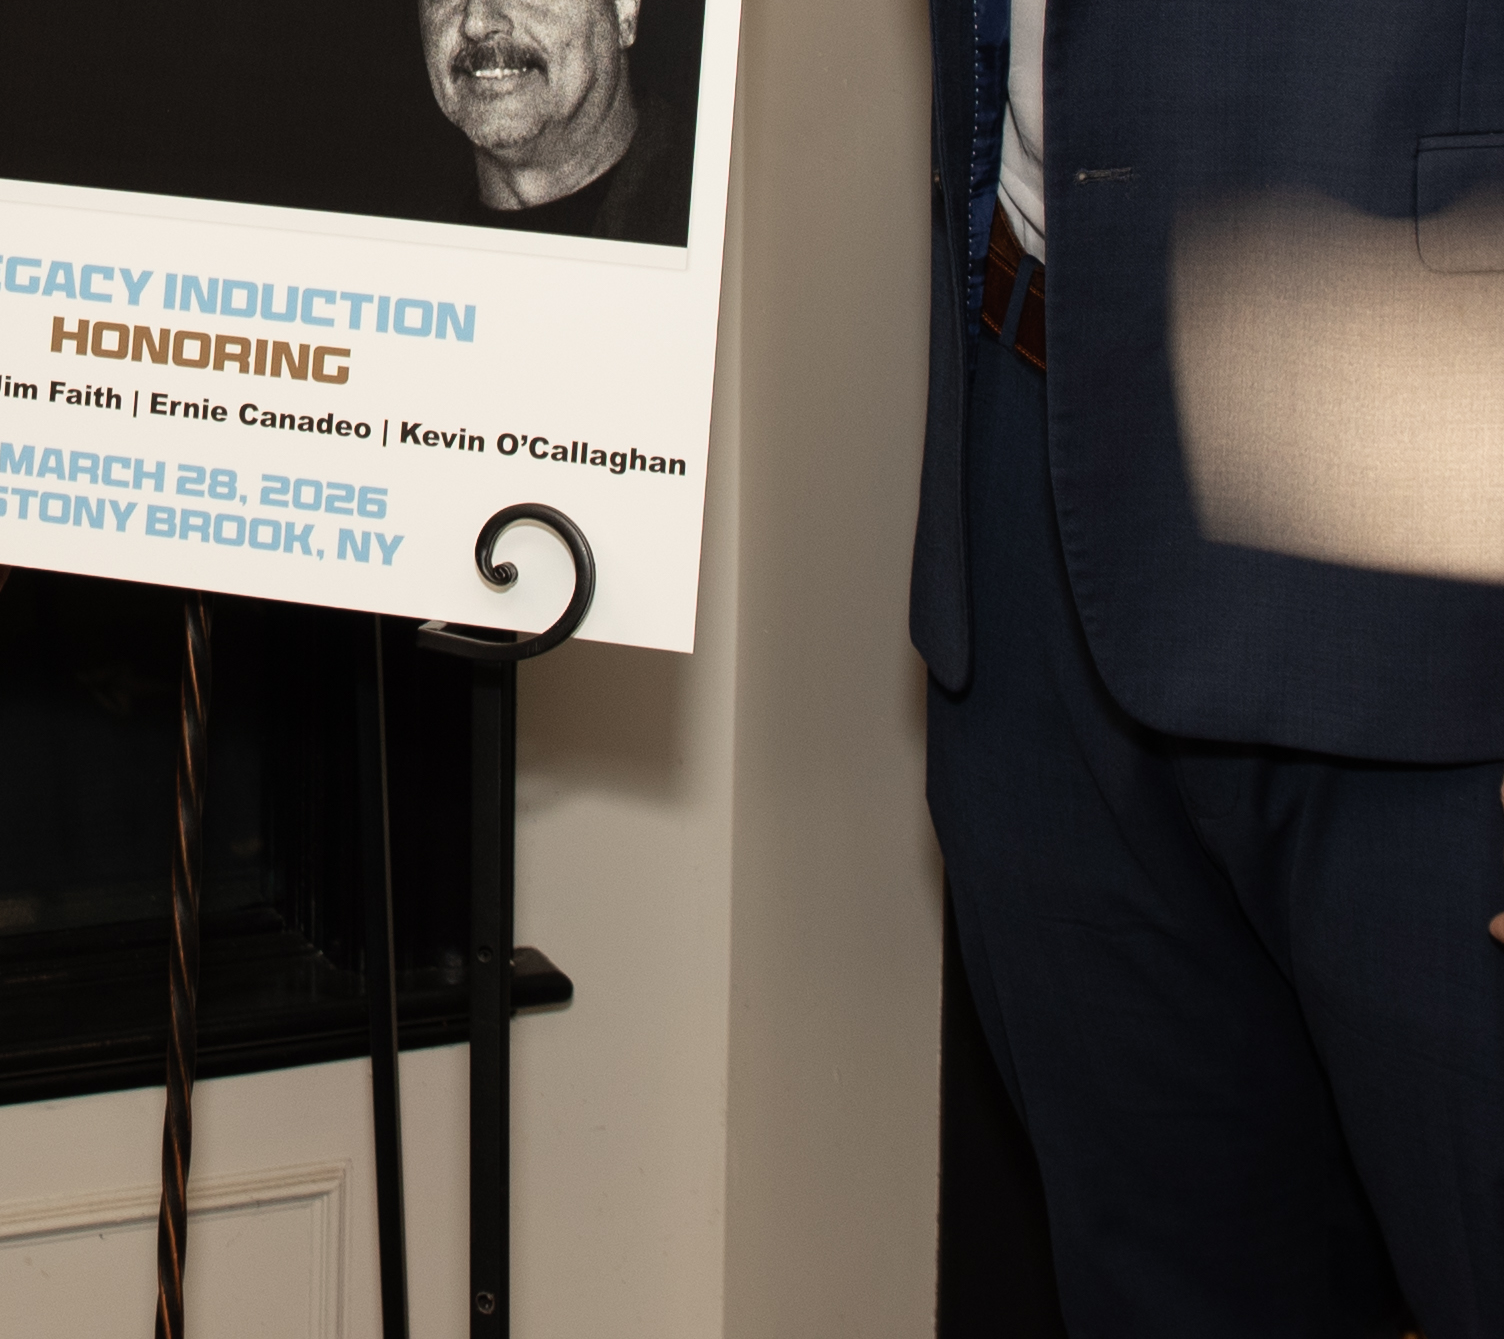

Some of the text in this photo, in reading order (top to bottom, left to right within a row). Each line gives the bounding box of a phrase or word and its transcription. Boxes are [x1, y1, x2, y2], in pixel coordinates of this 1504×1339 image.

[163, 272, 476, 343] INDUCTION
[51, 316, 351, 385] HONORING
[49, 381, 121, 410] Faith
[150, 392, 227, 422] Ernie
[239, 403, 371, 439] Canadeo
[401, 421, 484, 453] Kevin
[176, 463, 247, 506] 28,
[260, 474, 388, 520] 2026
[145, 503, 324, 561] BROOK,
[337, 528, 404, 567] NY
